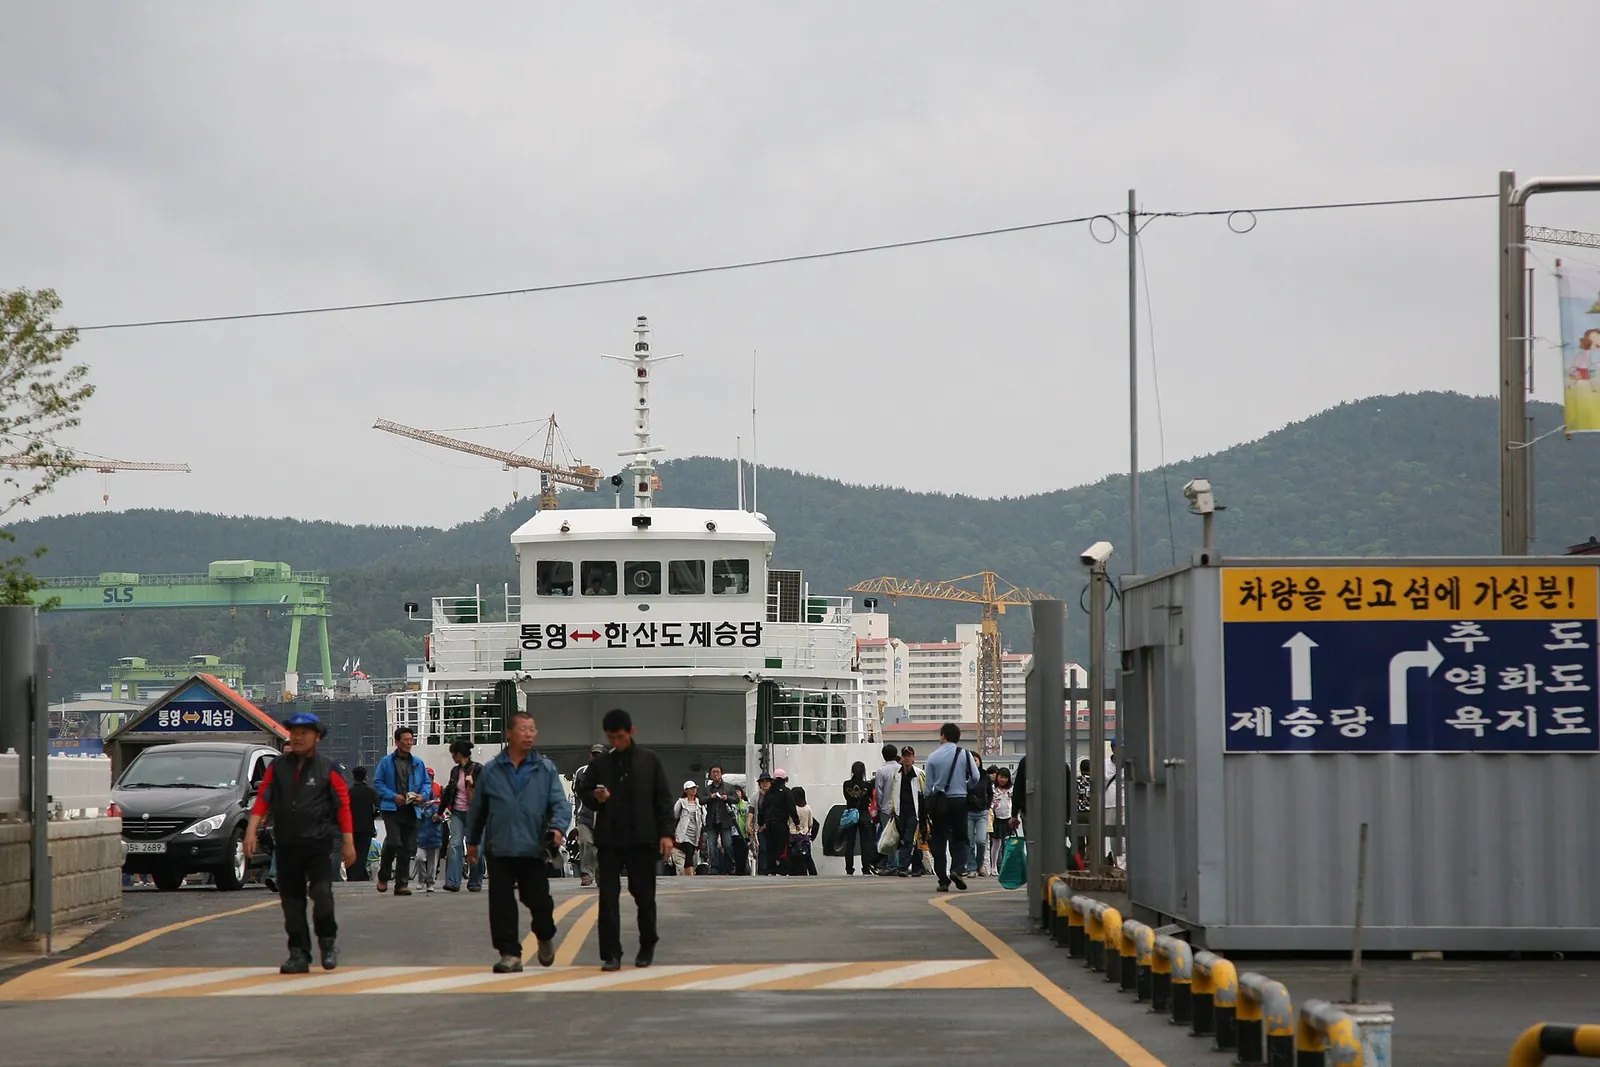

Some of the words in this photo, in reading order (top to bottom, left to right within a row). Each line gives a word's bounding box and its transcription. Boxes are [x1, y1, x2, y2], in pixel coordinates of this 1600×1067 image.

[103, 587, 134, 603] SLS
[1239, 576, 1327, 611] 차량을
[1337, 576, 1397, 611] 싣고
[1403, 575, 1460, 611] 섬에
[519, 622, 567, 650] 통영
[157, 709, 181, 727] 통영
[201, 708, 234, 727] 제승당
[1229, 705, 1374, 738] 제승당
[1444, 705, 1592, 737] 욕지도
[142, 843, 162, 852] 2689
